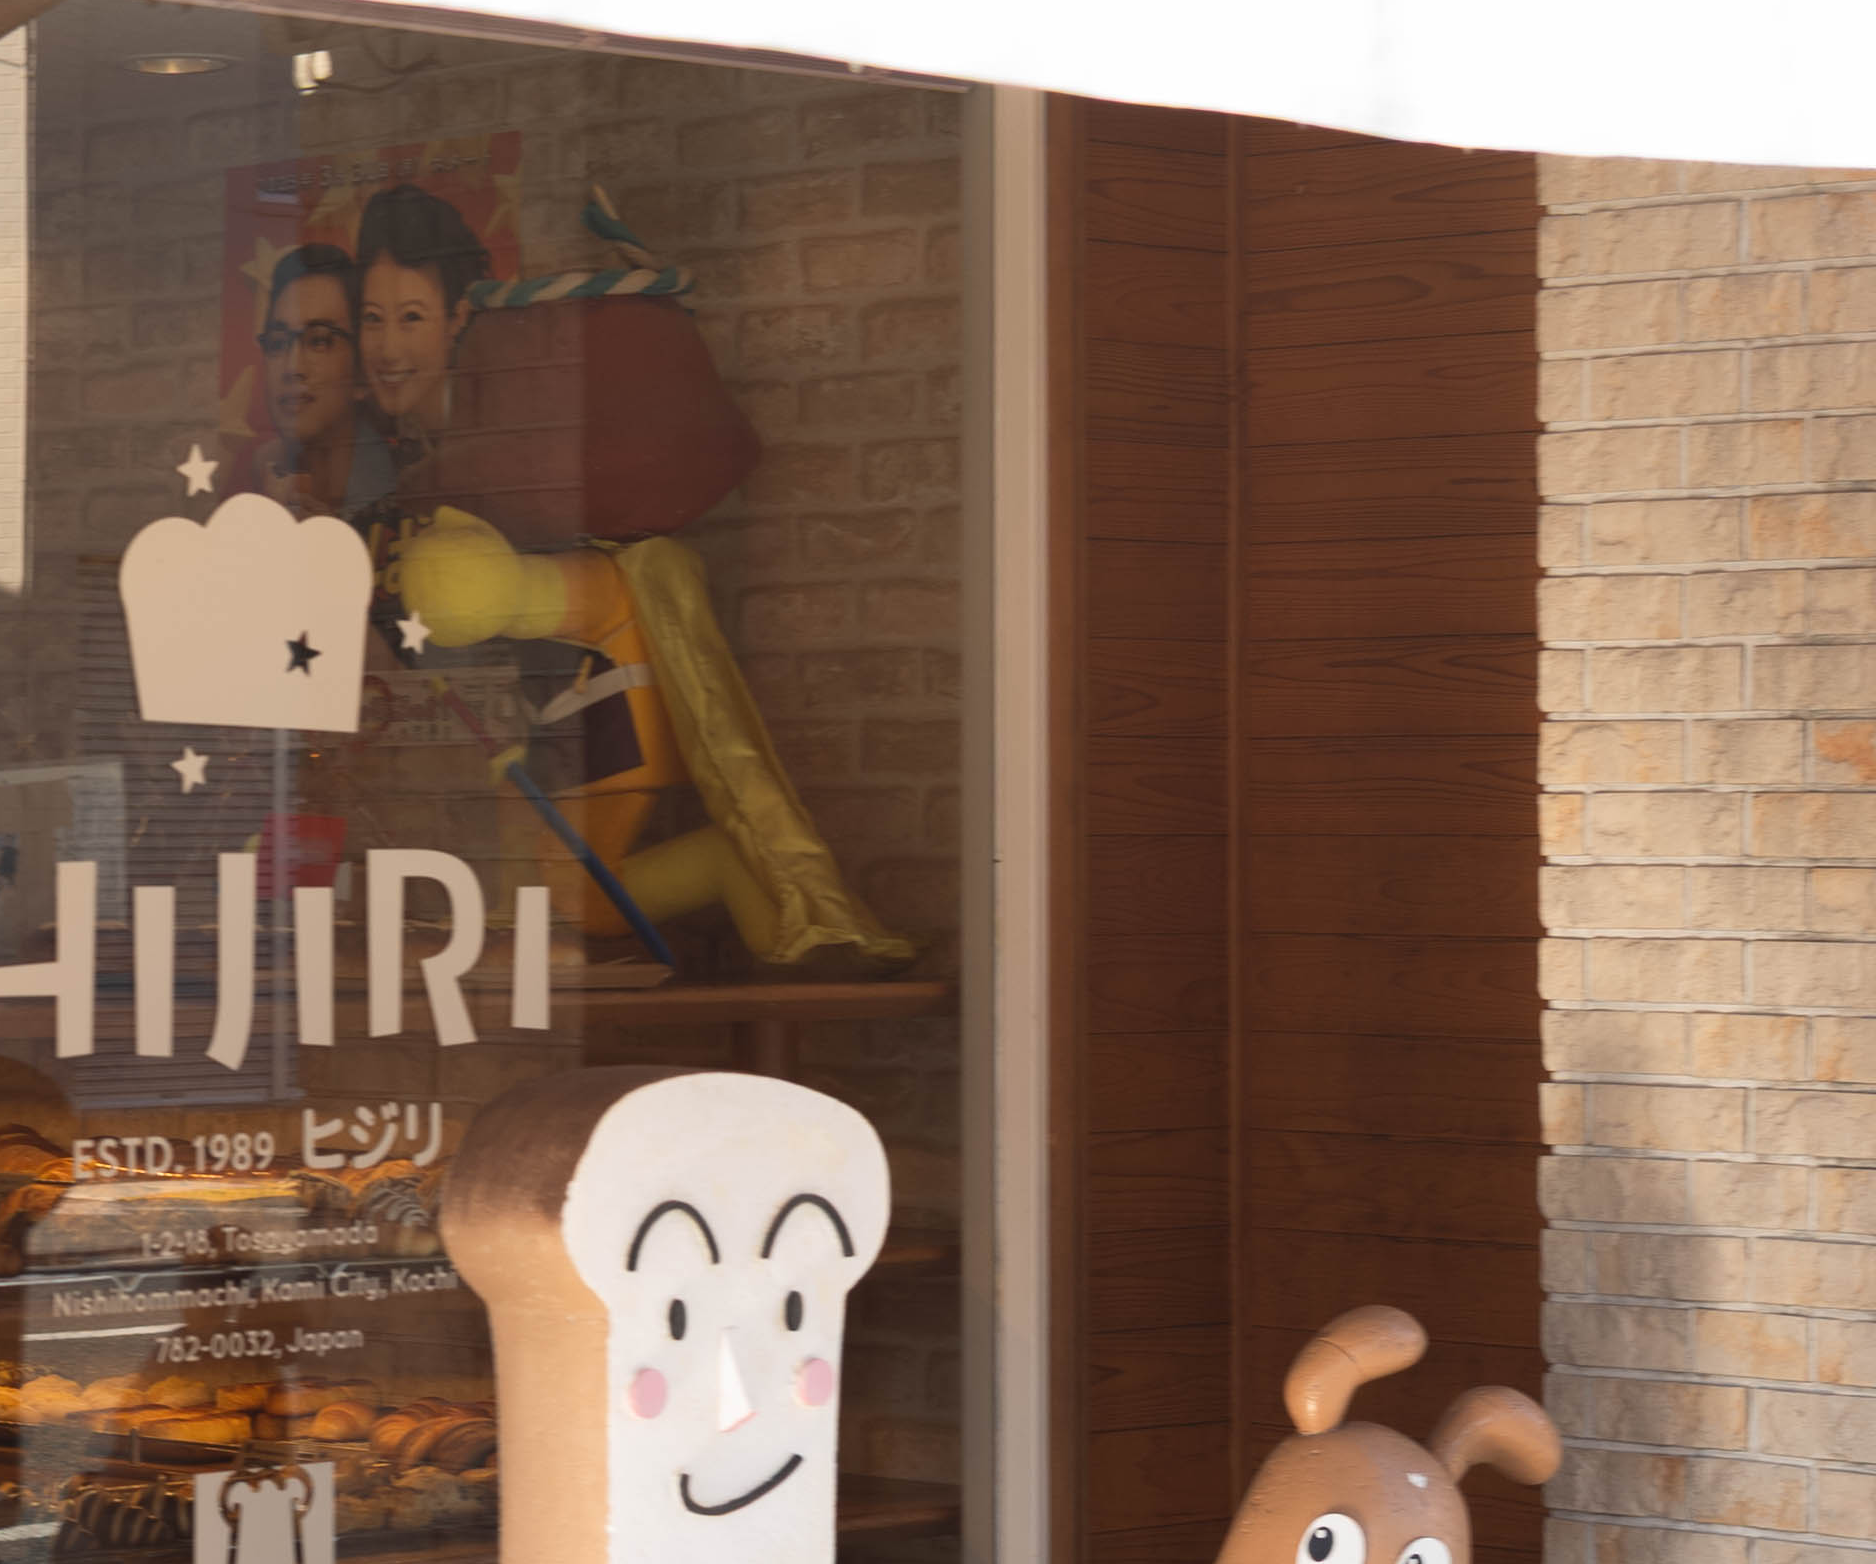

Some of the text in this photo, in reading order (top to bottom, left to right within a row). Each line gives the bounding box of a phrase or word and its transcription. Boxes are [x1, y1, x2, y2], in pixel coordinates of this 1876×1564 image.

[192, 1132, 275, 1172] 1989
[302, 1101, 443, 1169] ヒジリ
[262, 1278, 323, 1302] Kami
[330, 1272, 388, 1300] City,
[391, 1264, 458, 1294] Kochi
[155, 1327, 365, 1364] 782-0032, Japan
